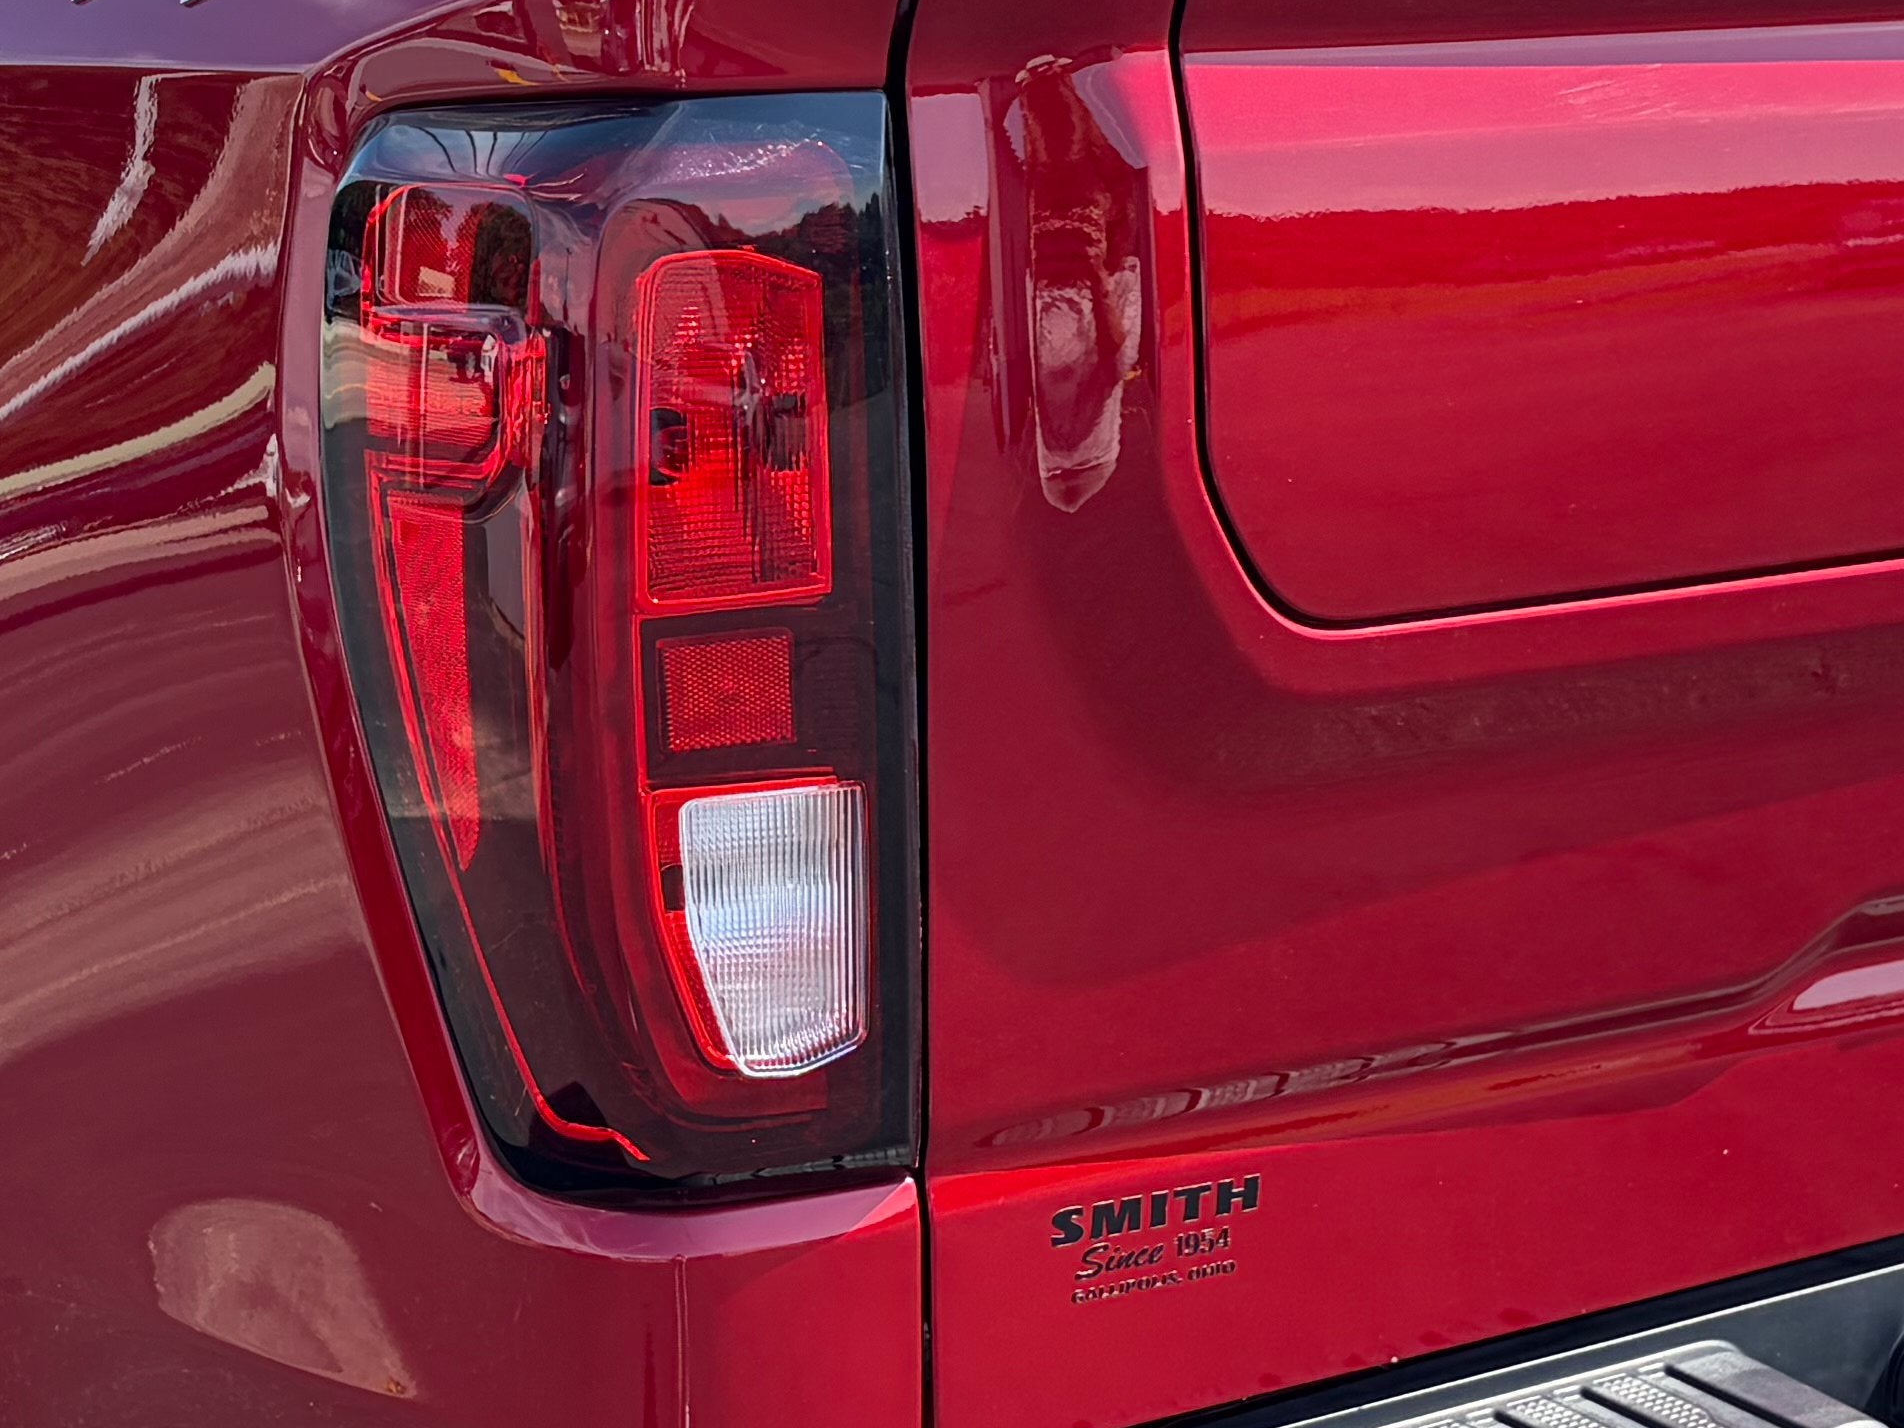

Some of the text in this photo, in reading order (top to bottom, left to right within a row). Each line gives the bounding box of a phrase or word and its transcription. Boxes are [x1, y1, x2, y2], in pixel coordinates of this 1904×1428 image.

[1050, 1173, 1260, 1248] SMITH
[1074, 1225, 1231, 1281] Since 1954
